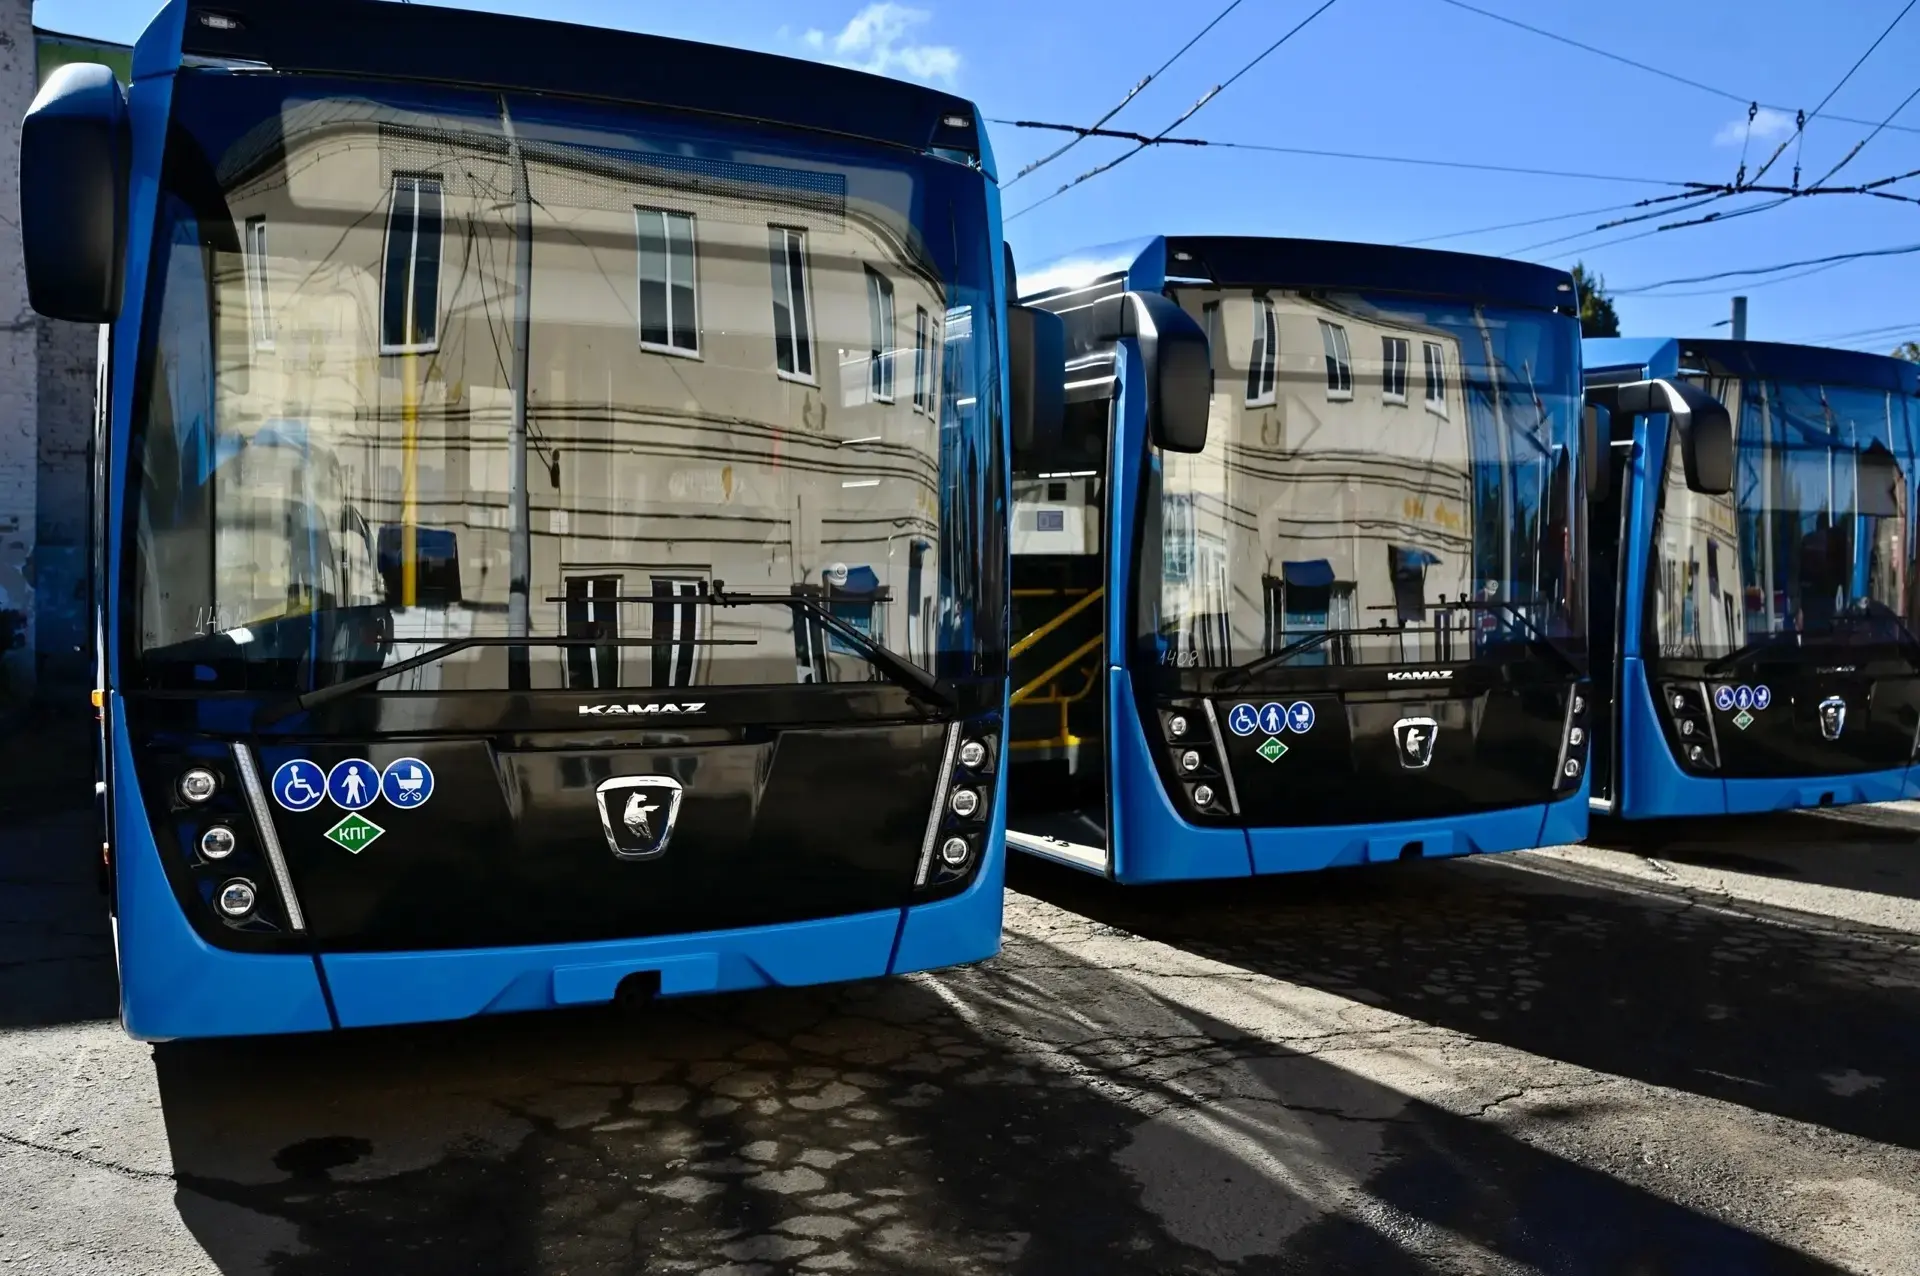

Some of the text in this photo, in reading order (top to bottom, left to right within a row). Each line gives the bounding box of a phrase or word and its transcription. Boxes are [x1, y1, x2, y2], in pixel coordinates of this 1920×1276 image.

[1160, 650, 1199, 667] 1408
[1387, 670, 1453, 681] KAMAZ
[578, 702, 707, 716] KAMAZ
[1264, 745, 1282, 755] КПГ
[339, 826, 371, 841] КПГ
